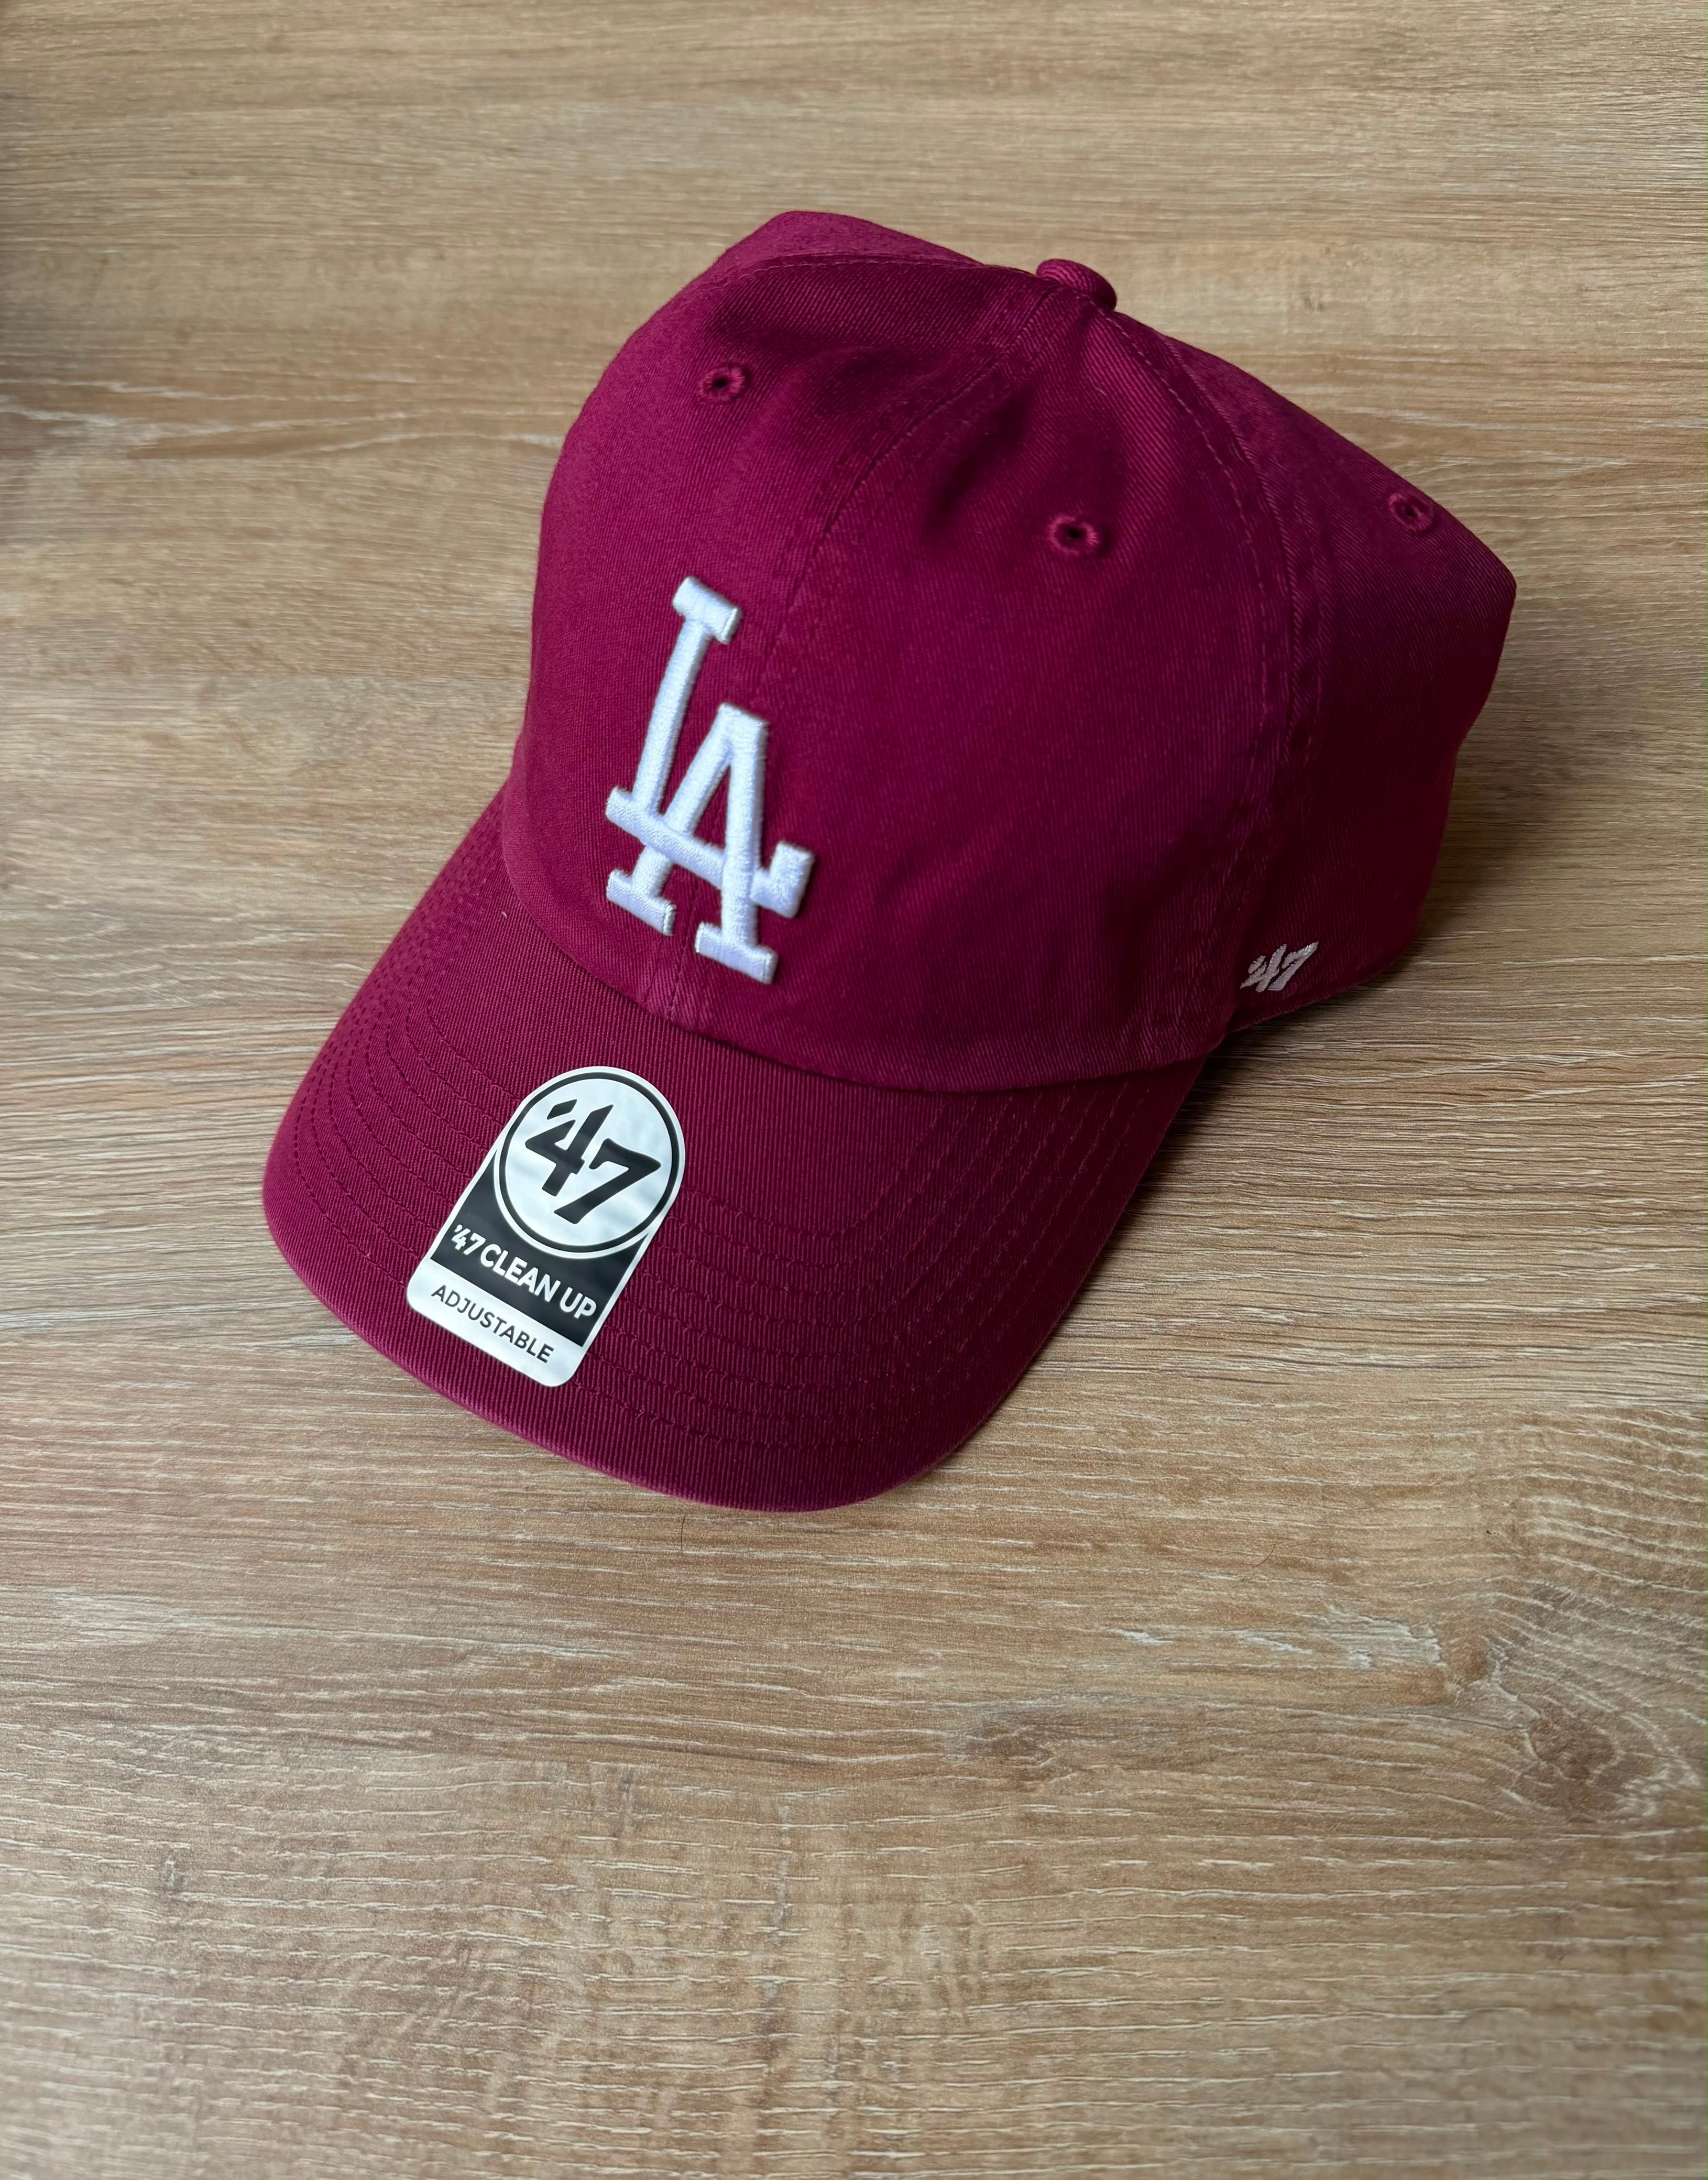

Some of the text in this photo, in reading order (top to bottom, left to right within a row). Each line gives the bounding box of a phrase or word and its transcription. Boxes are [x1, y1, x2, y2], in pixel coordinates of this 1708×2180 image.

[606, 575, 815, 985] LA
[480, 1243, 560, 1303] CLEAN
[560, 1291, 597, 1320] UP
[431, 1284, 554, 1364] ADJUSTABLE
